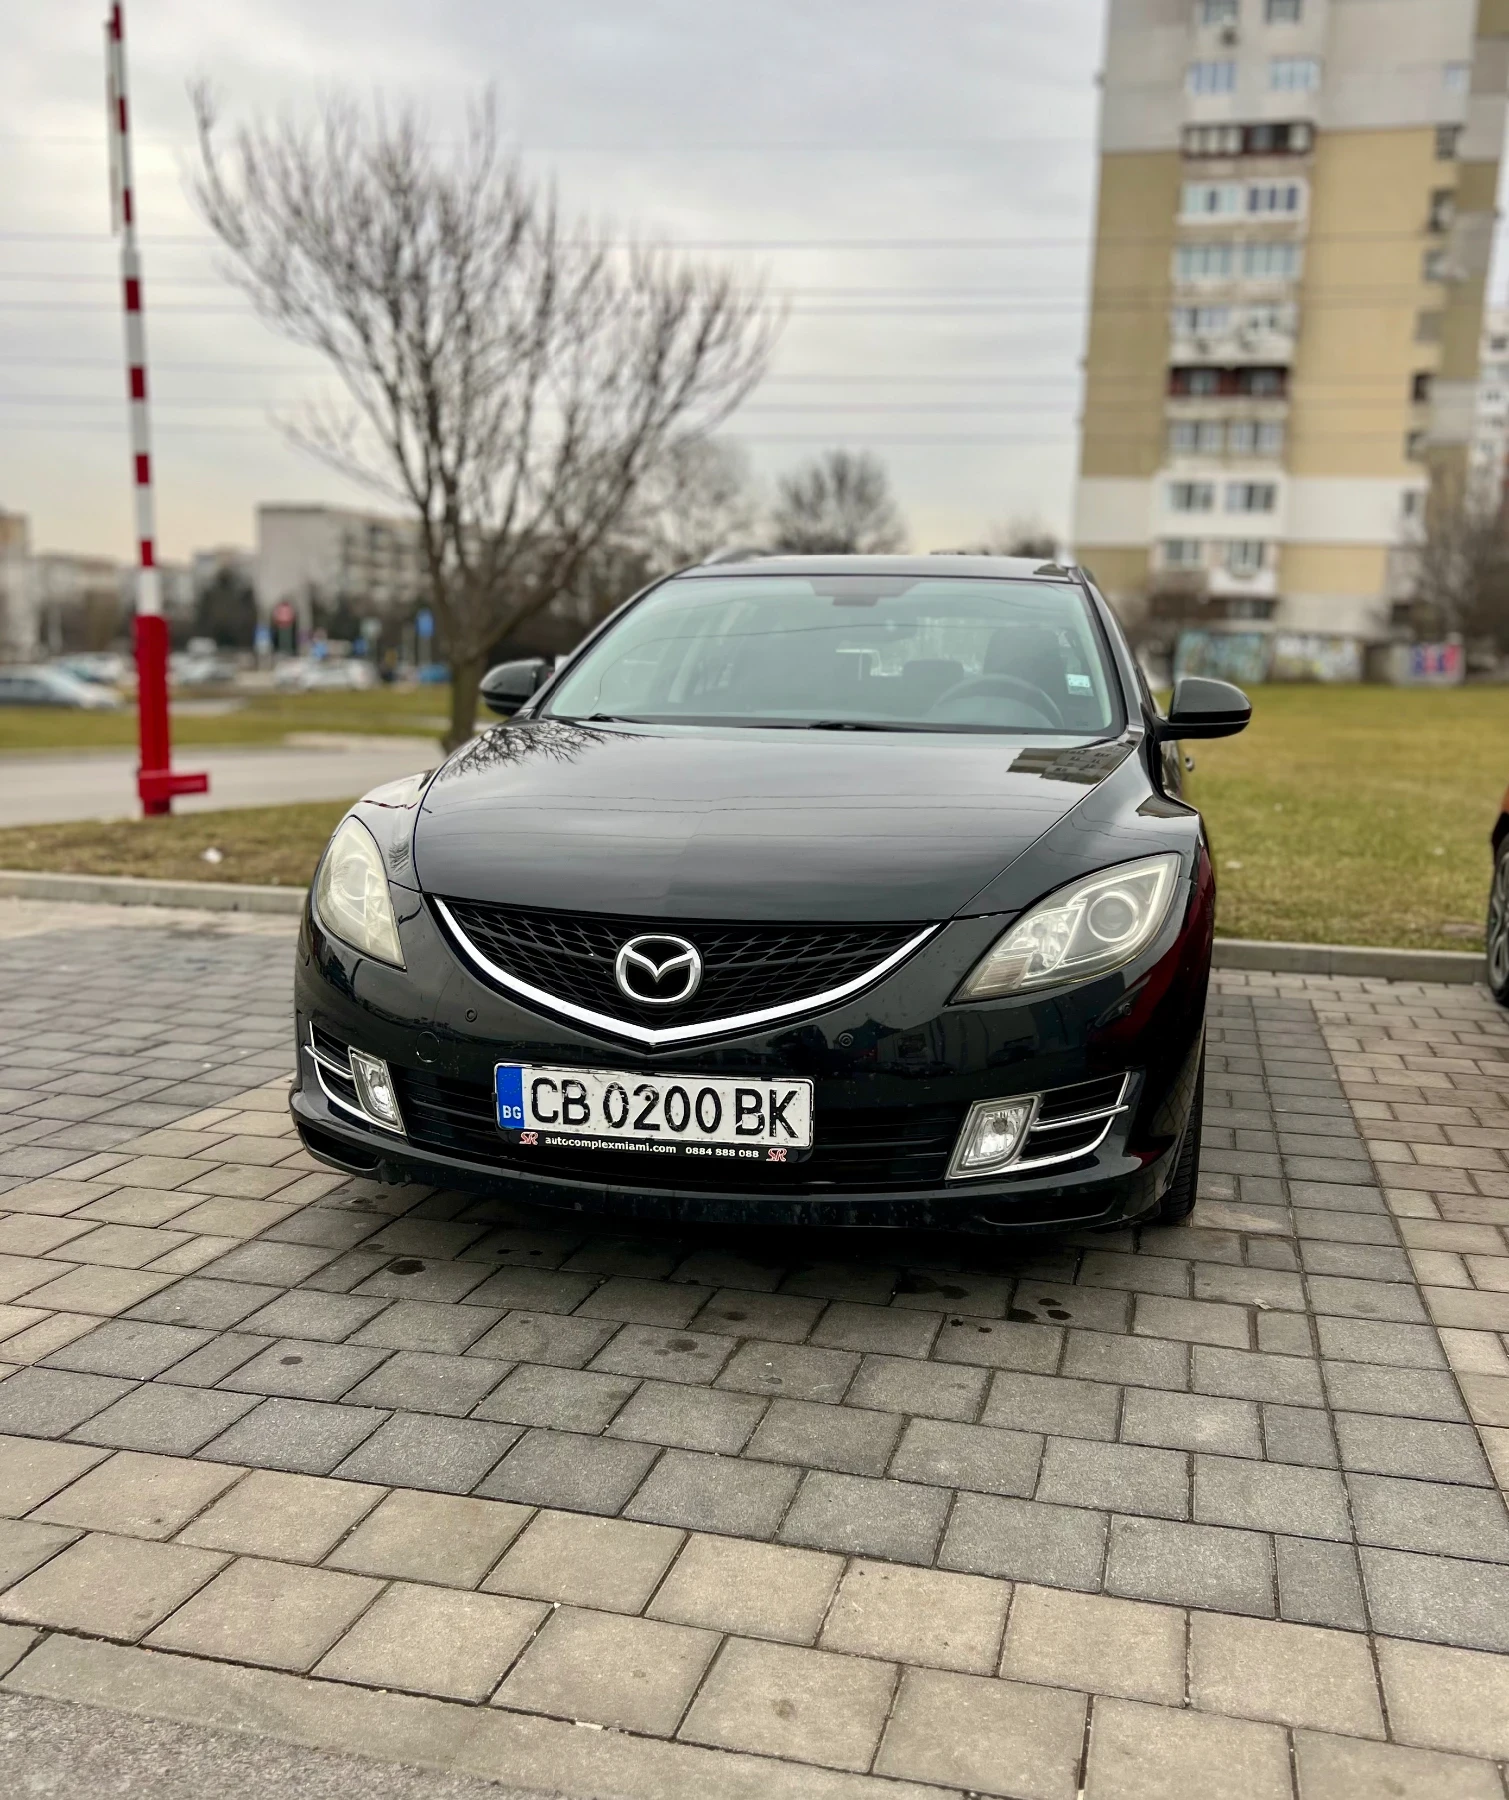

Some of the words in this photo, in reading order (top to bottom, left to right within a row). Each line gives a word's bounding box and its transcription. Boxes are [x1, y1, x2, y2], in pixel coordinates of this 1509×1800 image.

[502, 1104, 522, 1119] BG
[531, 1076, 591, 1126] CB
[603, 1081, 722, 1134] 0200
[735, 1087, 799, 1138] BK
[545, 1136, 677, 1154] autocomplexmiami.com
[685, 1146, 713, 1156] 0884
[715, 1148, 736, 1157] 888
[738, 1149, 760, 1158] 088
